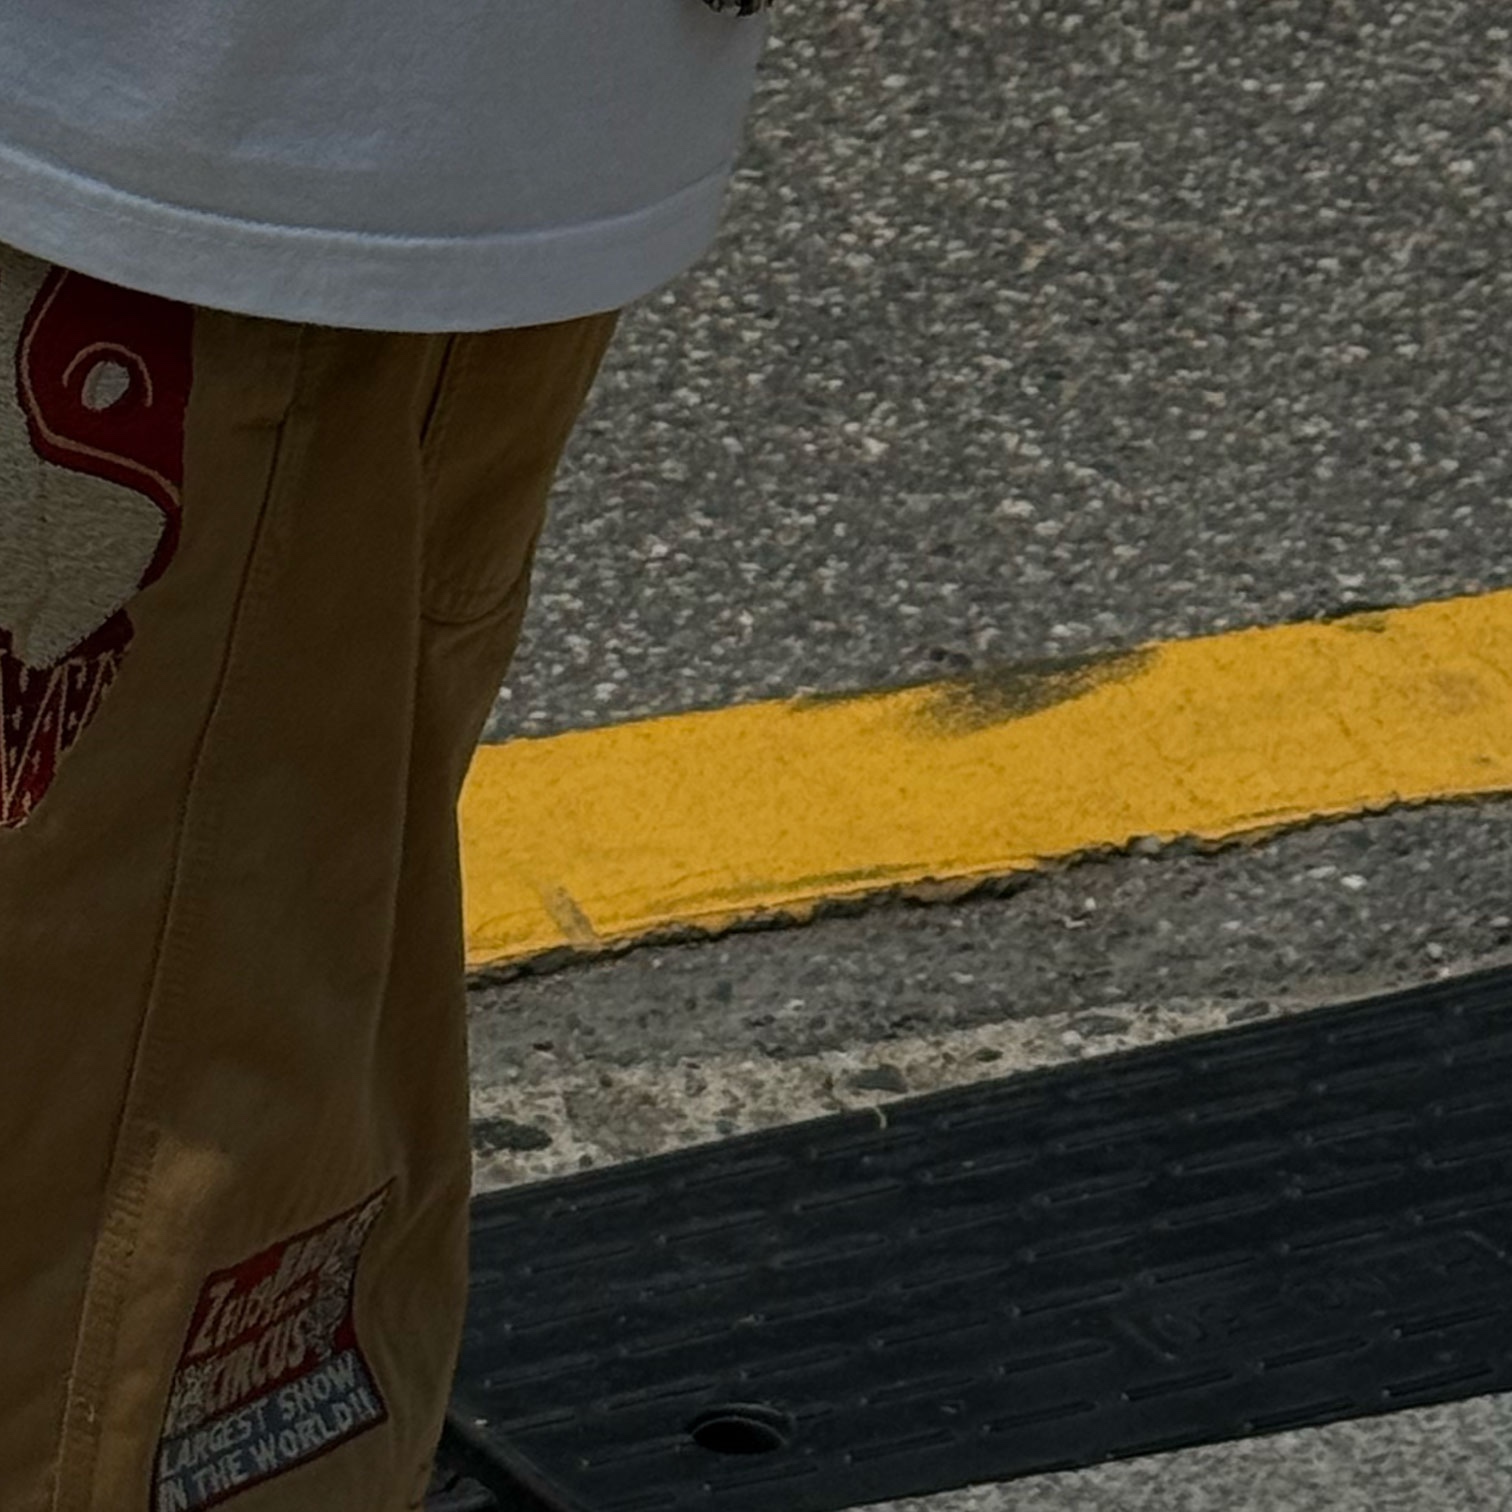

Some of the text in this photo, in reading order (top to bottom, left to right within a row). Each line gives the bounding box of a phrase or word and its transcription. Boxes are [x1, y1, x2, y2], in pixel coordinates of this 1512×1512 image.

[160, 1350, 356, 1480] LARGEST SHOW
[190, 1448, 250, 1499] THE
